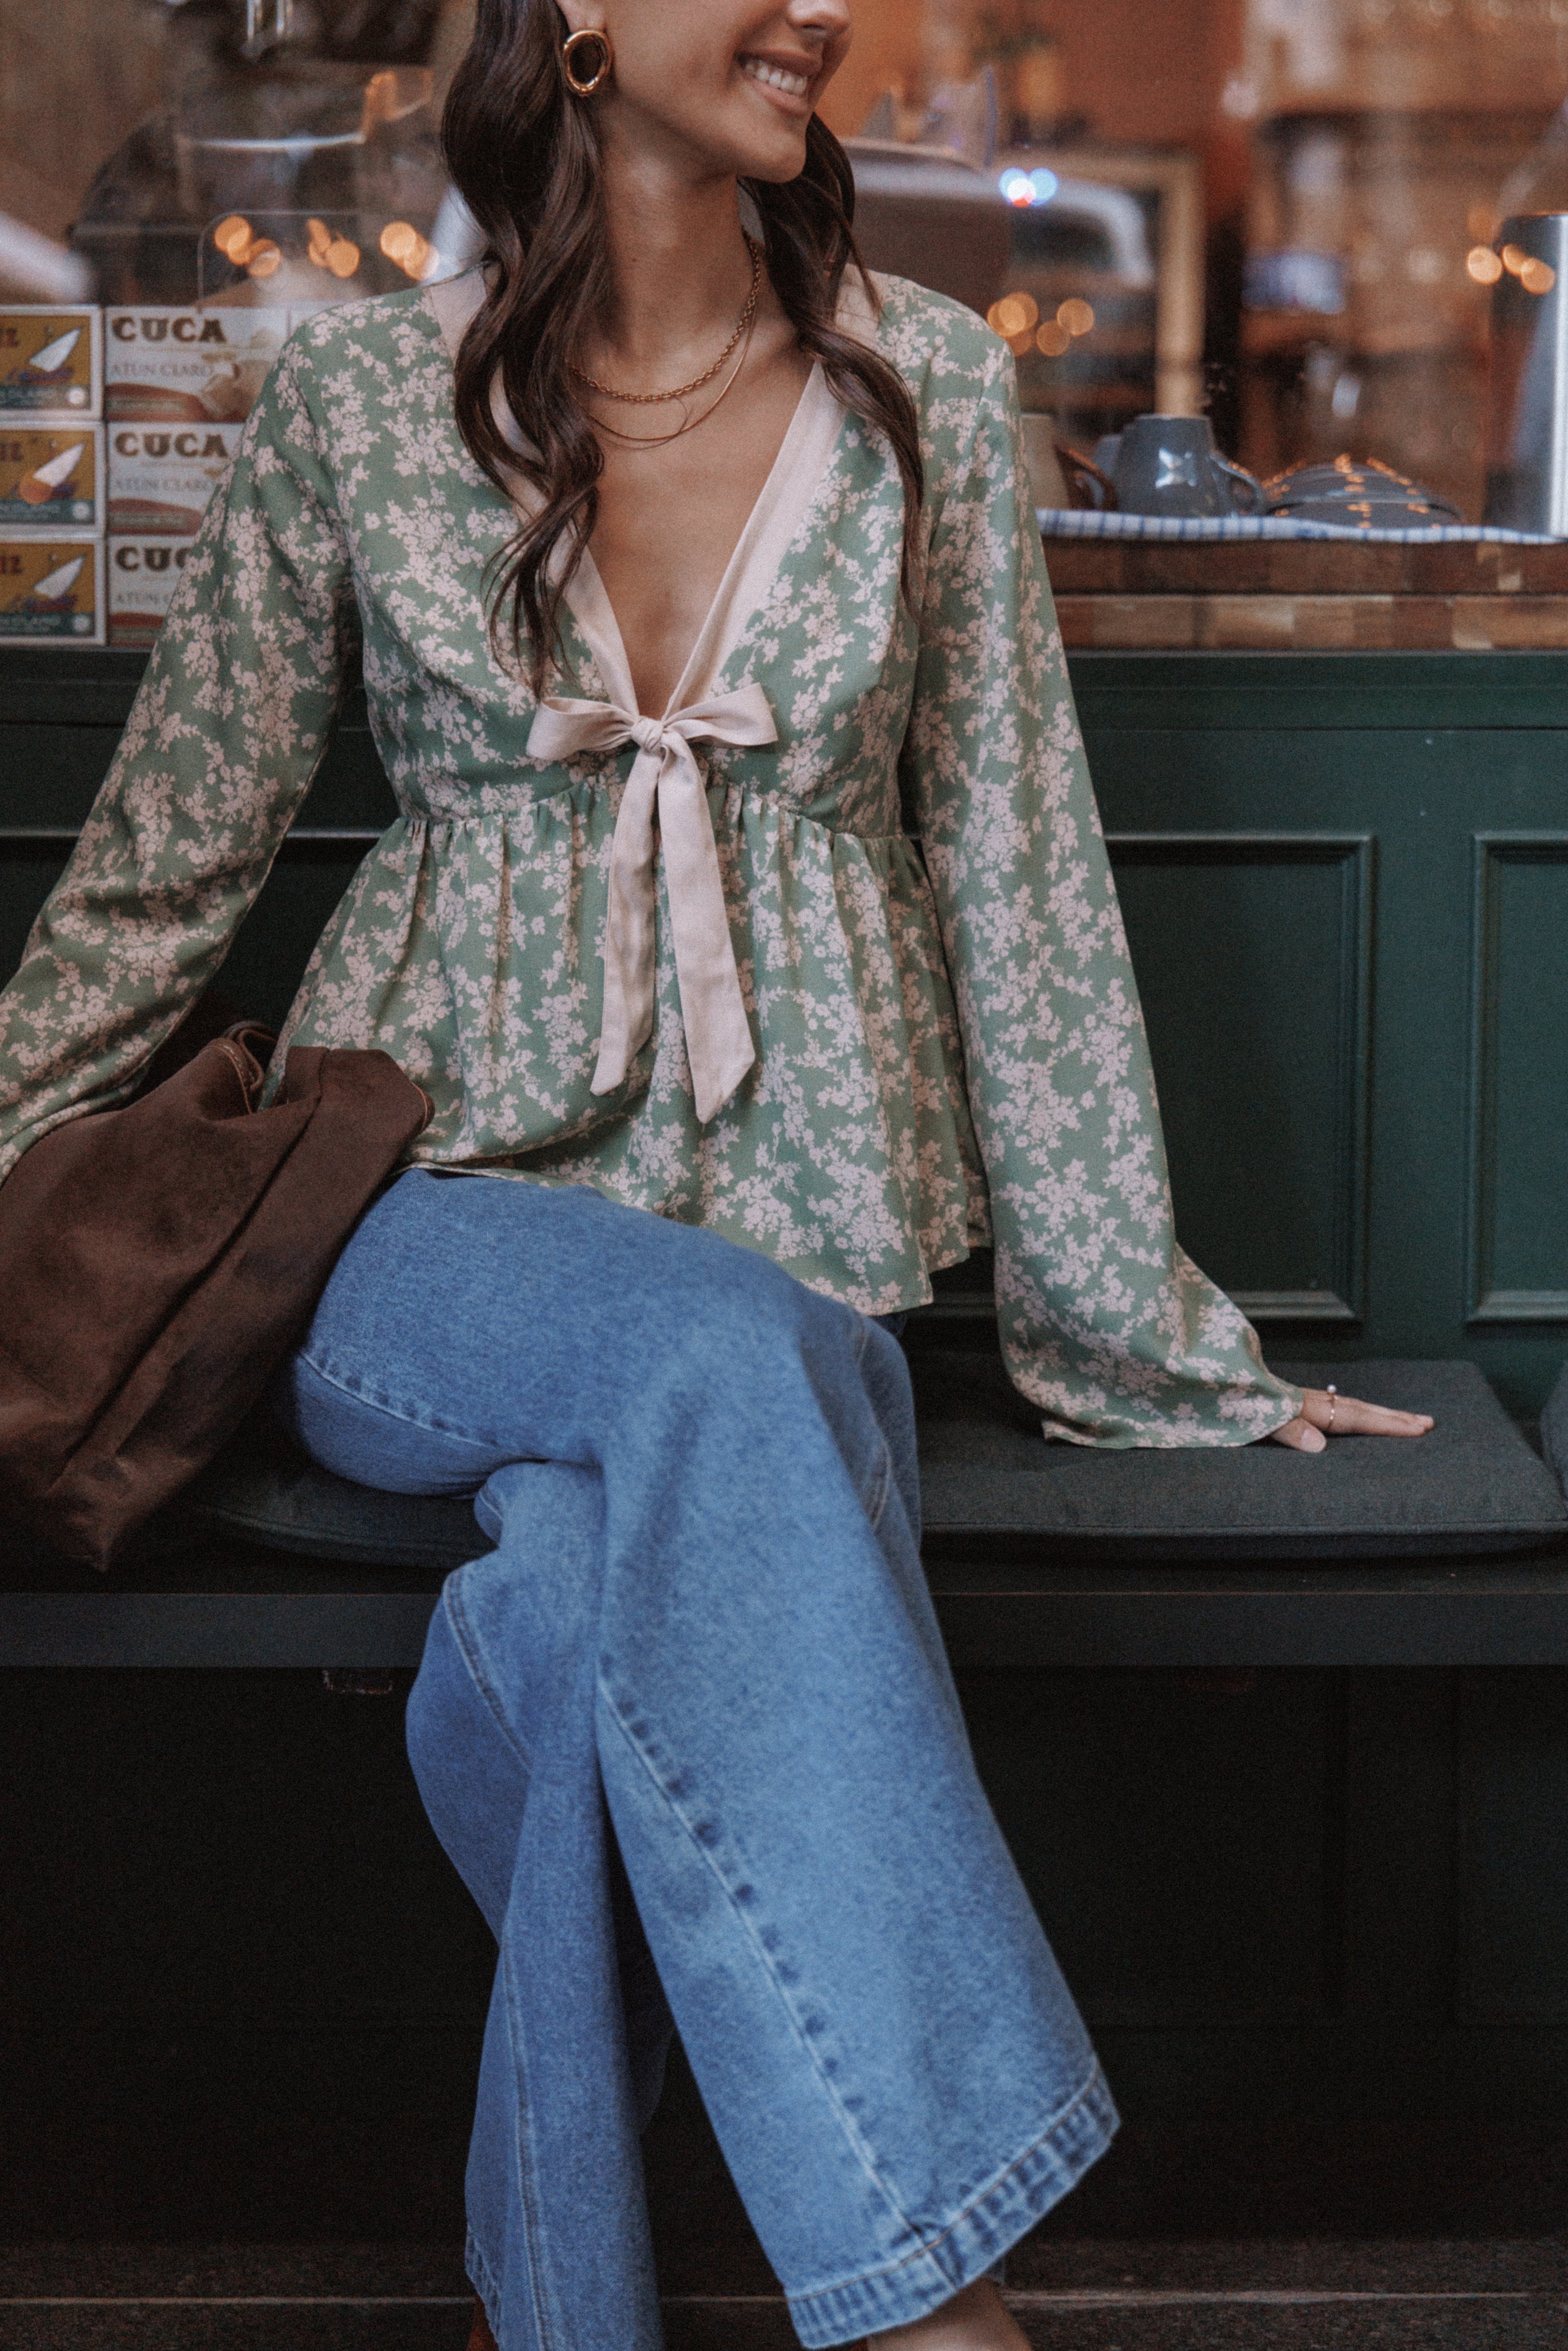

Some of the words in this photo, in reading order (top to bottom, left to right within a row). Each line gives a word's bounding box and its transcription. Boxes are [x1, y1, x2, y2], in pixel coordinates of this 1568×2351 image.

[111, 316, 227, 342] CUCA
[115, 432, 228, 457] CUCA
[116, 546, 190, 571] CUC
